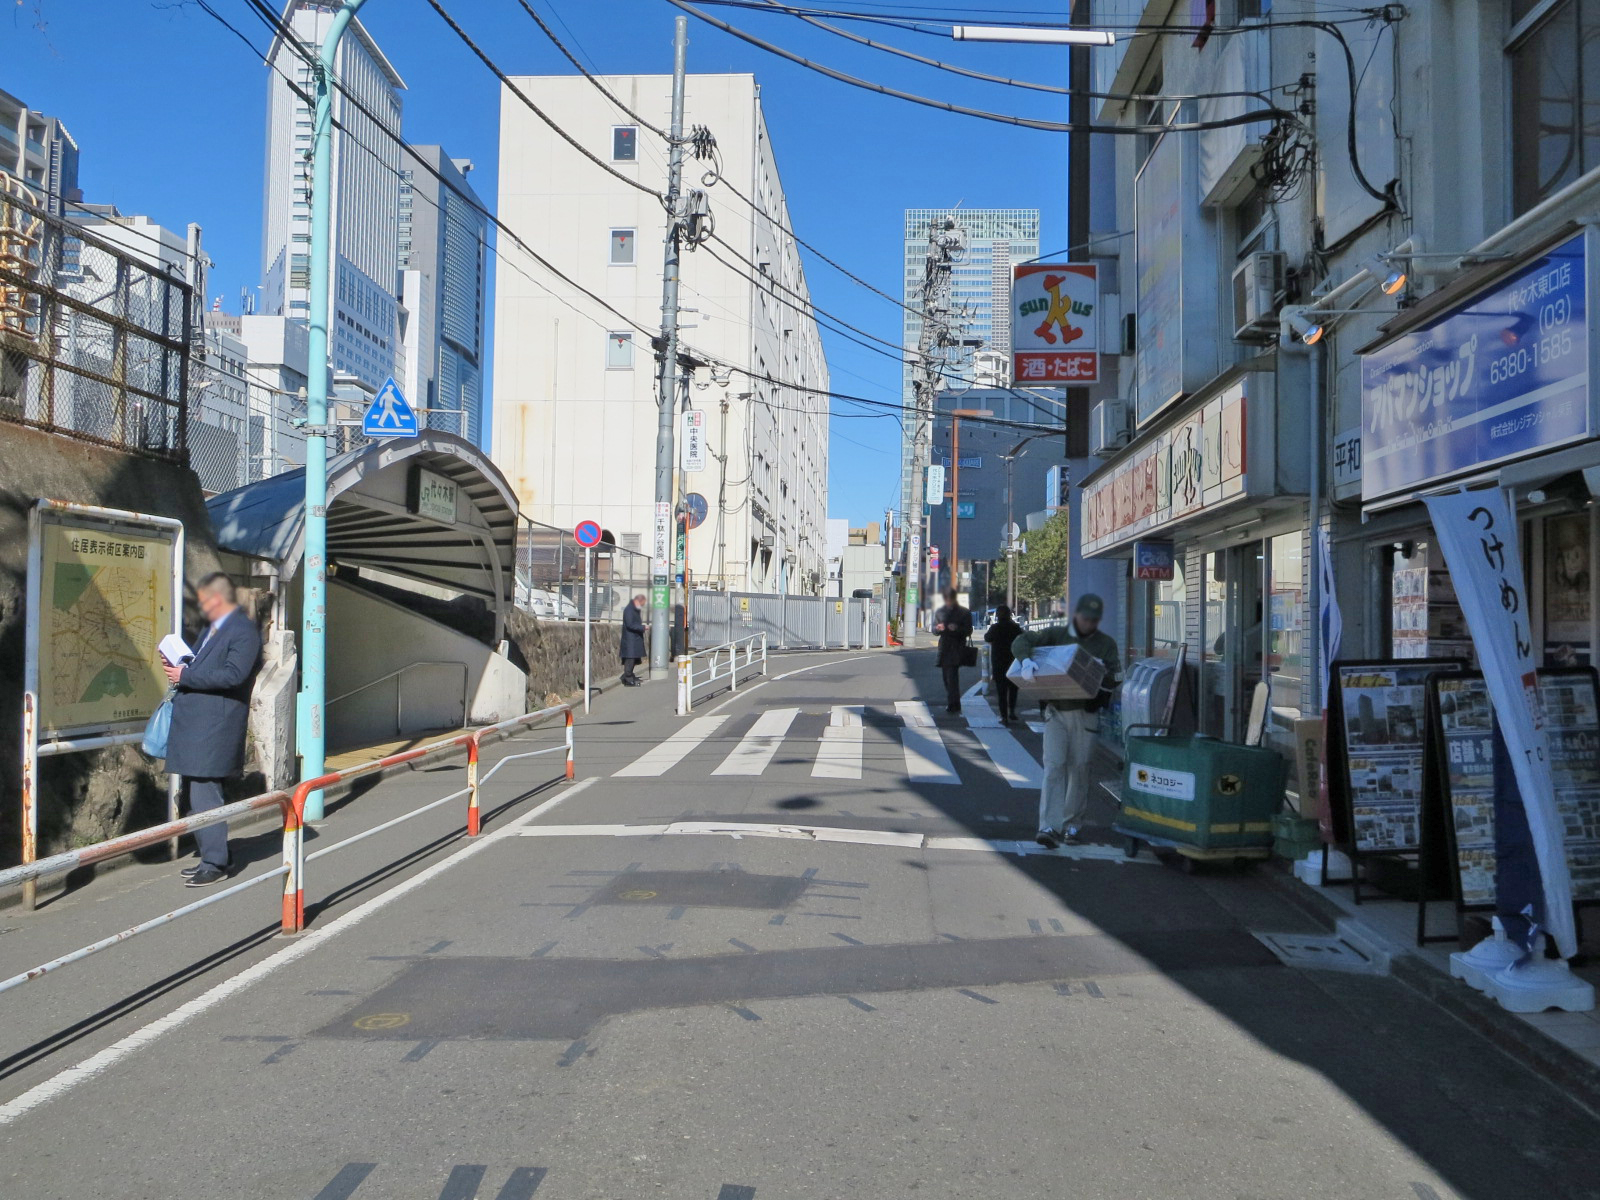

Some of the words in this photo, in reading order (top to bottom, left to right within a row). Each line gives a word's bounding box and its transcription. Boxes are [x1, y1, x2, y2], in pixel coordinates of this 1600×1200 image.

[1509, 262, 1571, 314] 代々木東口店
[1539, 294, 1571, 335] (03)
[1022, 357, 1093, 378] 酒・たばこ
[1490, 328, 1572, 385] 6380-1585
[1370, 333, 1478, 434] アパマンショップ
[690, 427, 698, 458] 中央医院
[71, 537, 145, 560] 住居表示街区案内図
[1140, 567, 1171, 578] ATM
[1467, 506, 1531, 661] つけめん
[1150, 773, 1183, 787] ネコロジー
